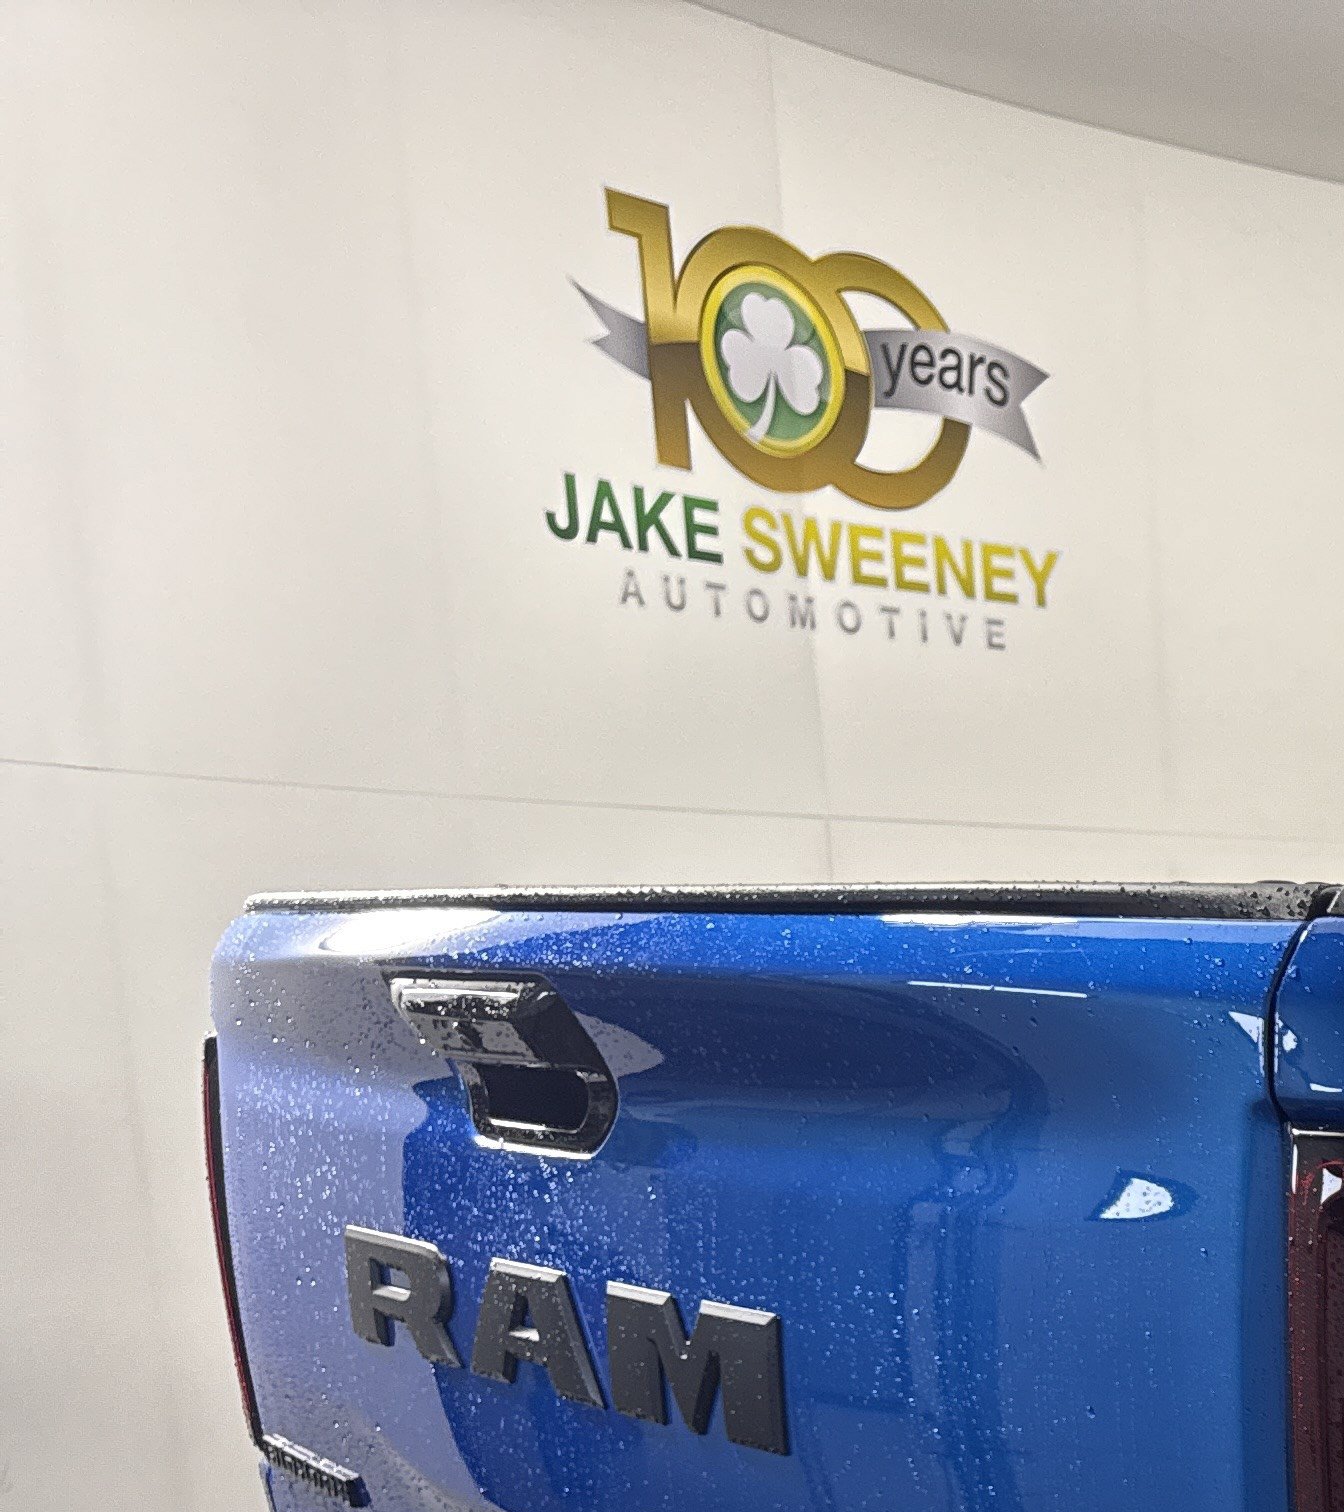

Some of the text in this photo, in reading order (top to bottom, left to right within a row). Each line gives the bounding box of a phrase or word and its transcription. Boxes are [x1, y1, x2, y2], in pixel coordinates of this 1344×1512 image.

[880, 339, 1011, 408] years
[545, 472, 1061, 608] JAKE SWEENEY
[618, 569, 1007, 652] AUTOMOTIVE
[344, 1224, 793, 1456] RAM
